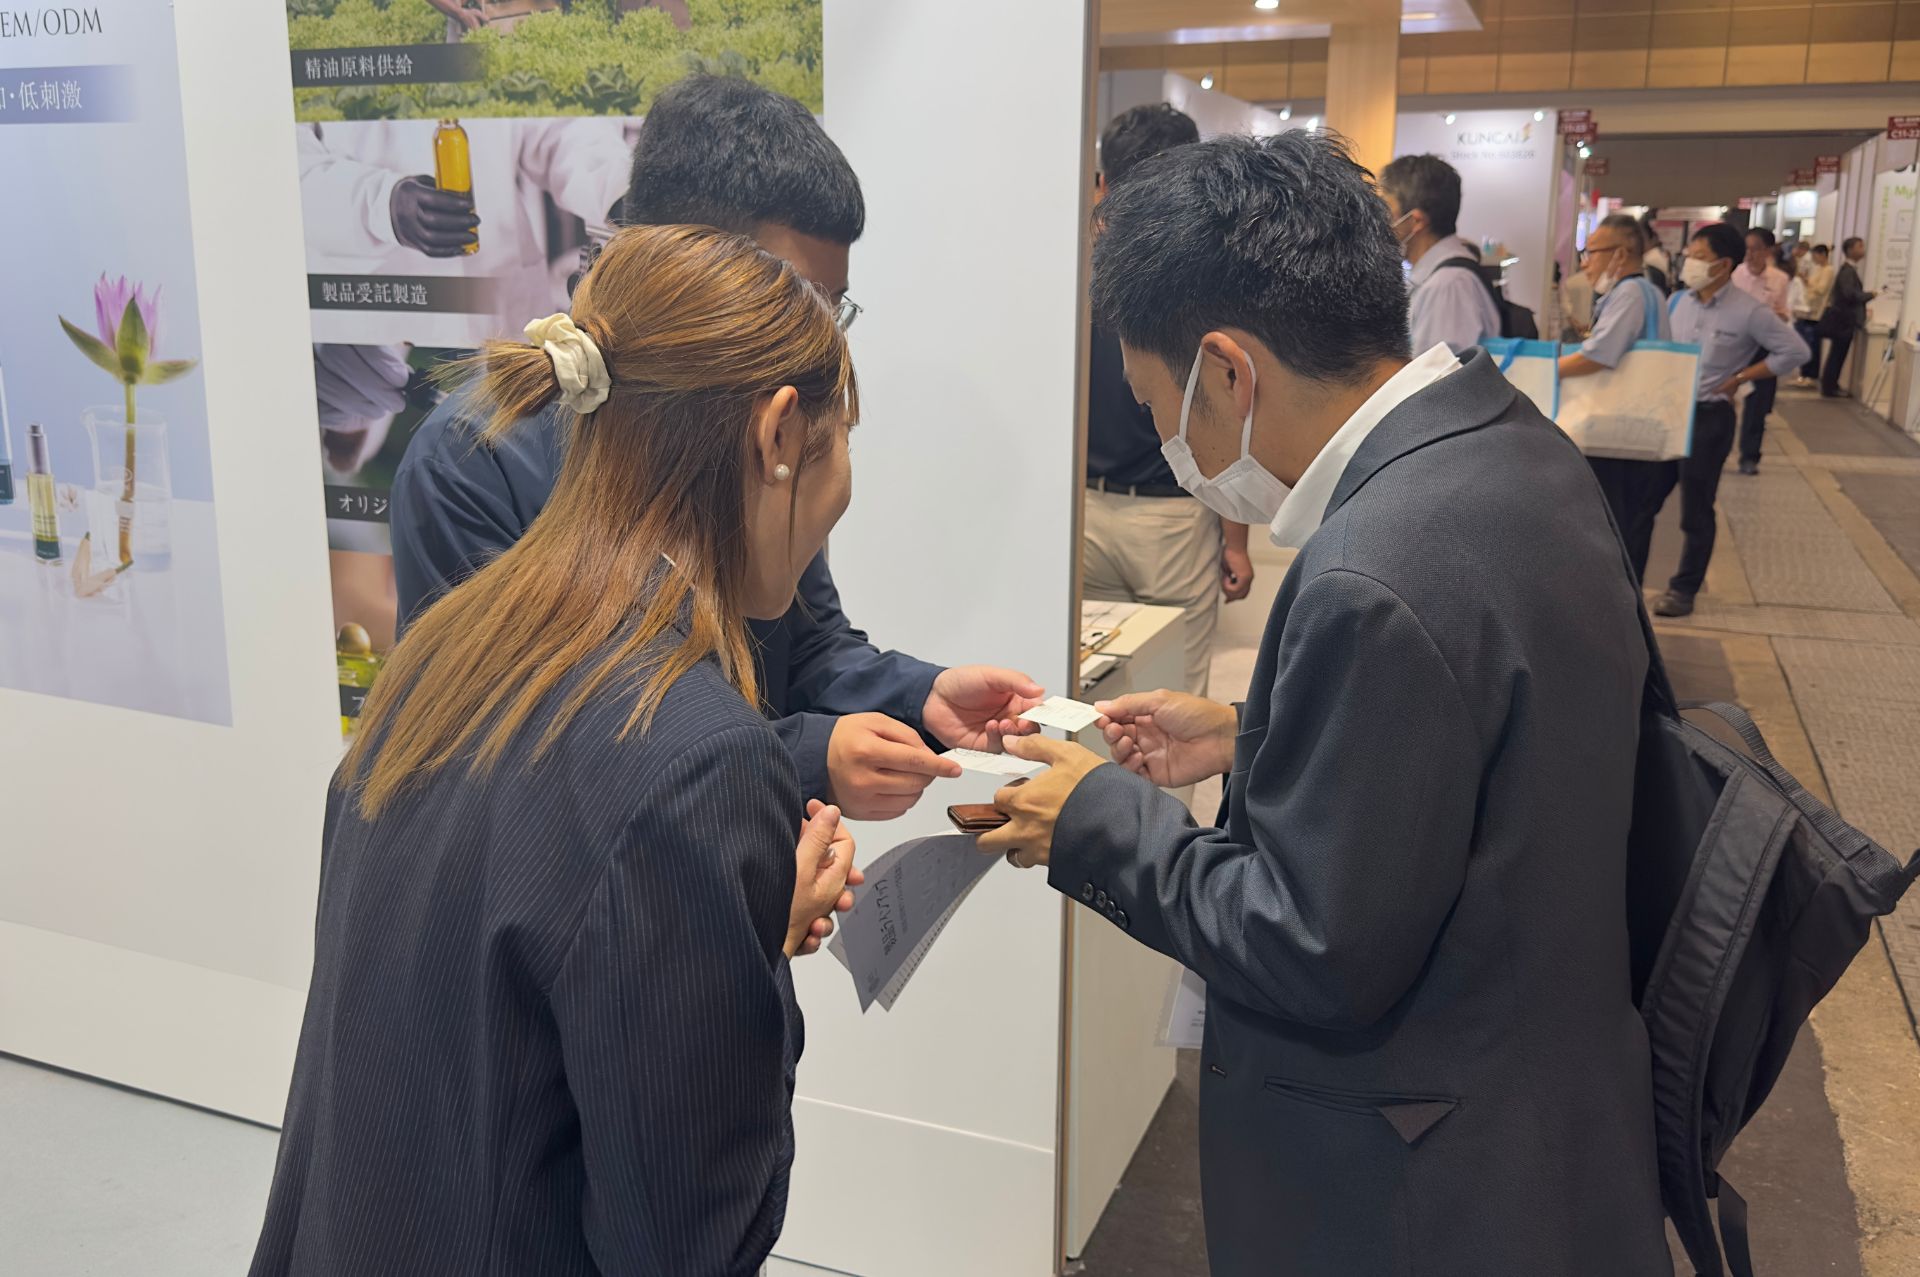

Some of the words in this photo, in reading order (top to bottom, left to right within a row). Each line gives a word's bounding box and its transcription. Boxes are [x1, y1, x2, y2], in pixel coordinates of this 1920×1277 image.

[305, 53, 413, 79] 精油原料供給
[322, 281, 428, 305] 製品受託製造
[338, 493, 388, 515] オリジ
